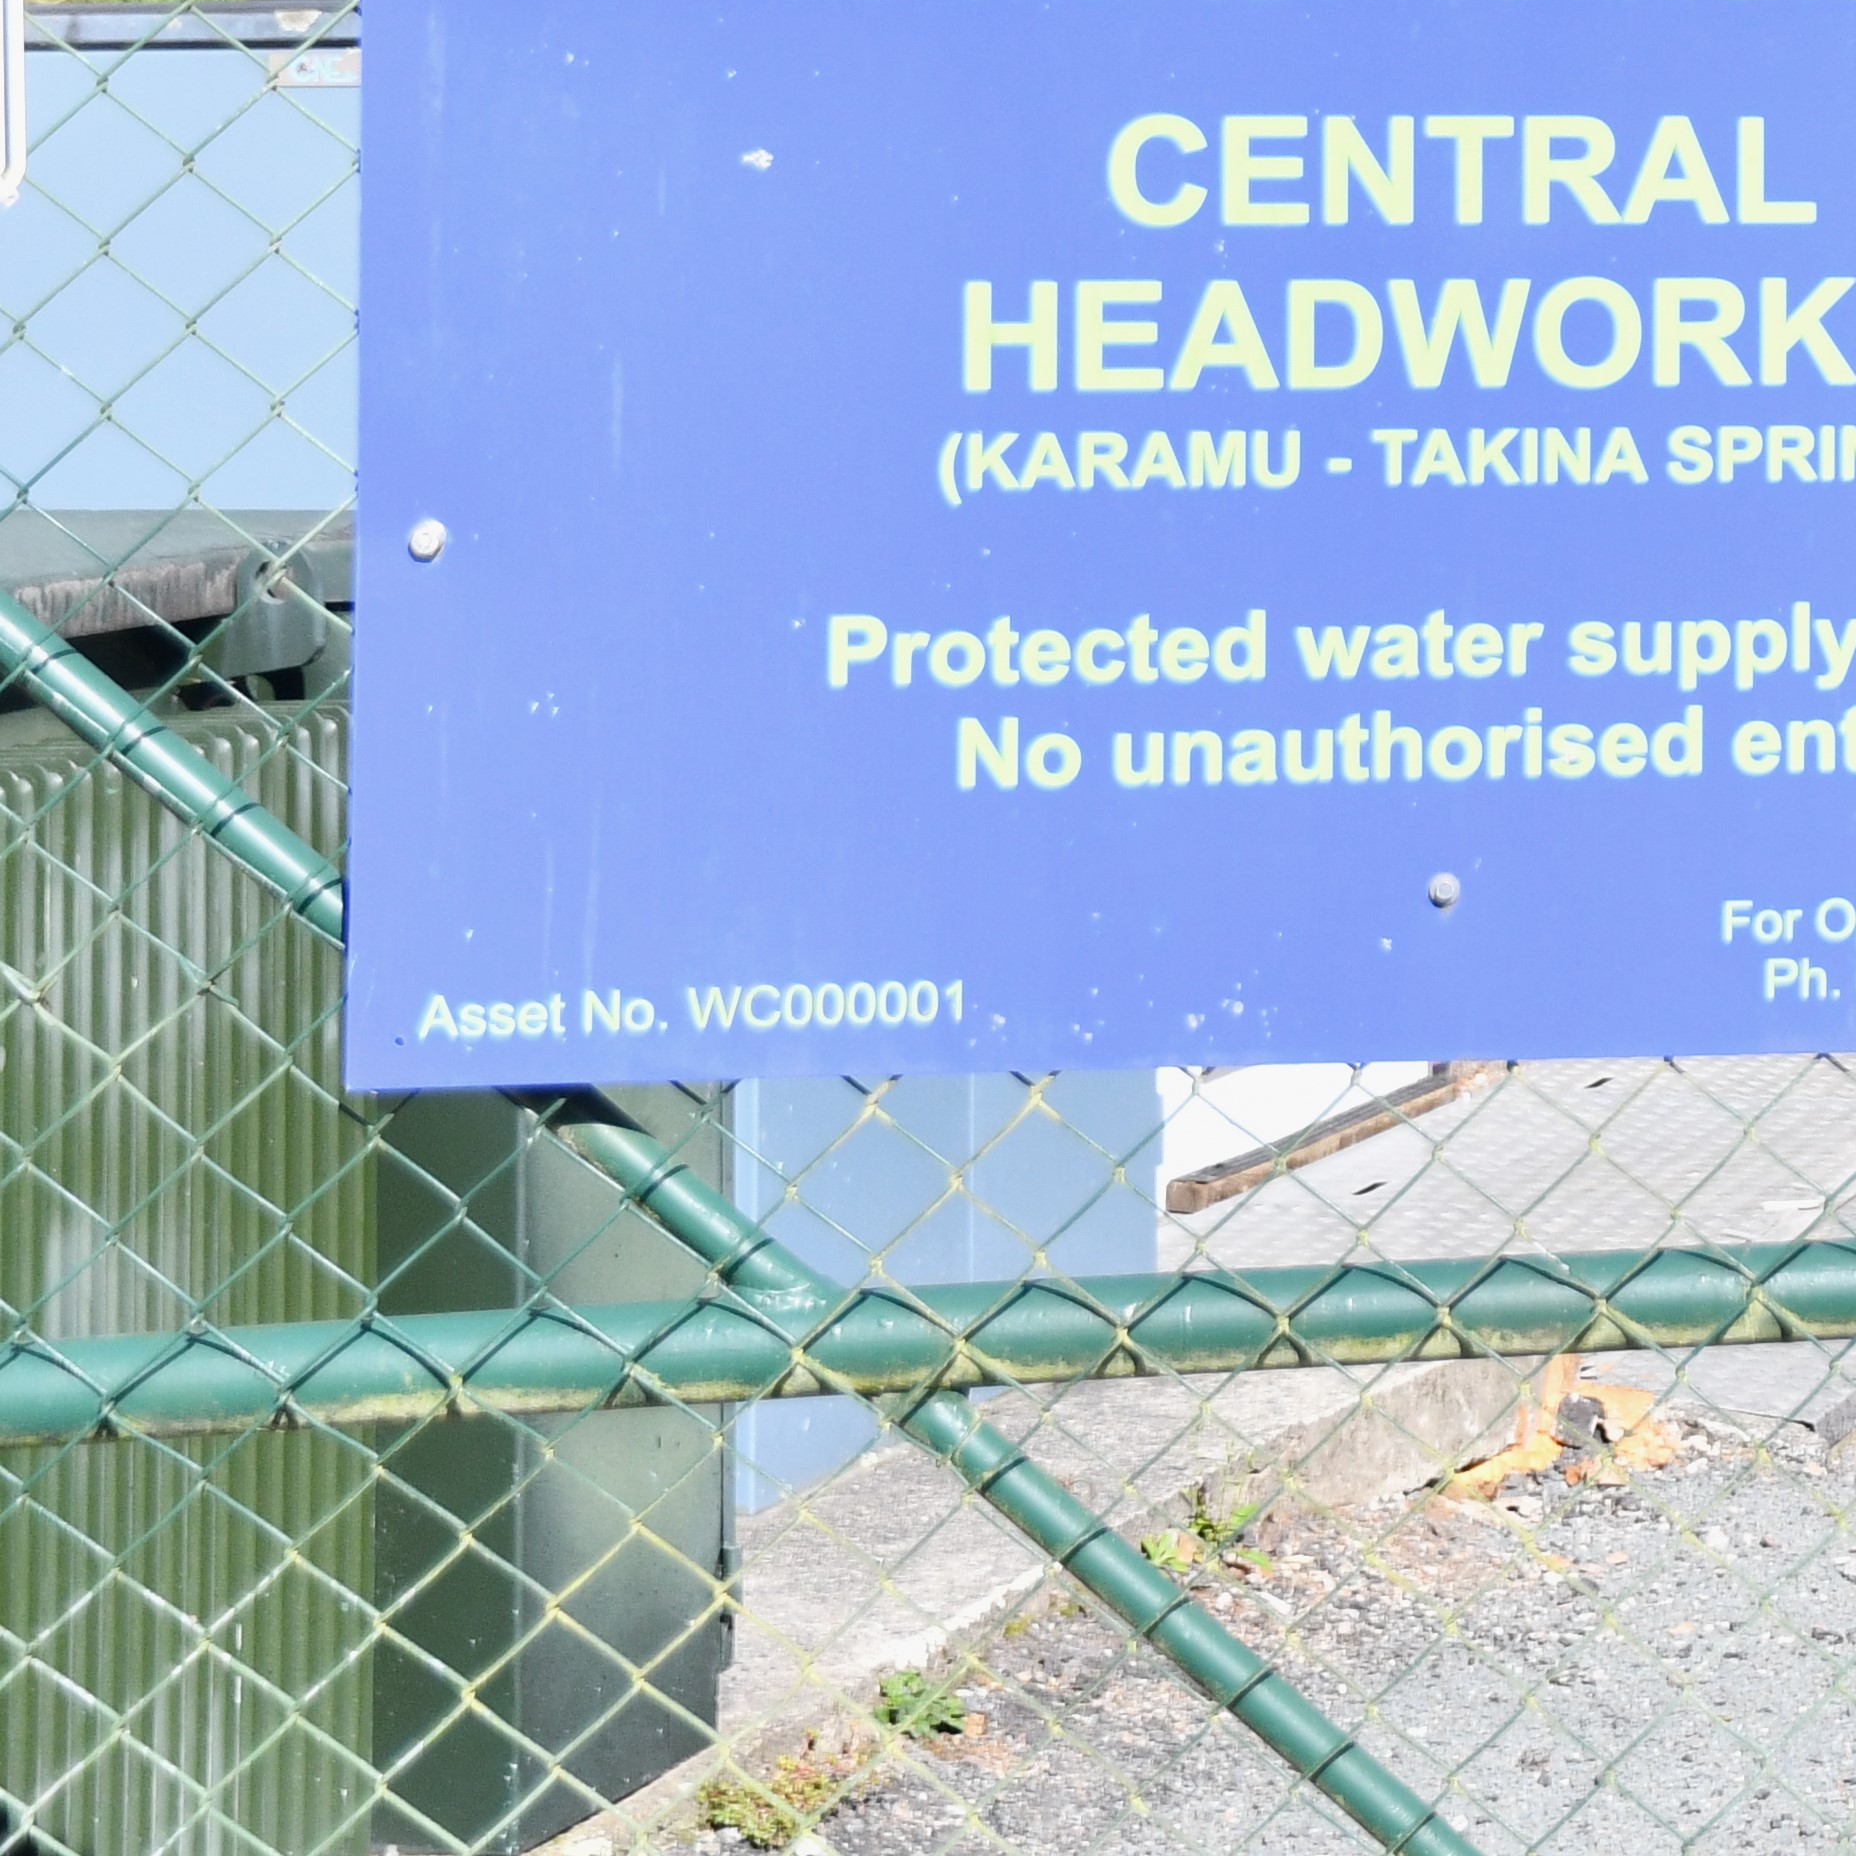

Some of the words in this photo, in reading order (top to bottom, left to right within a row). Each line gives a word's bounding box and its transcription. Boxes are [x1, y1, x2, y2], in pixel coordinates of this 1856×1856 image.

[1108, 113, 1817, 227] CENTRAL
[939, 430, 1301, 506] (KARAMU
[1371, 426, 1649, 486] TAKINA
[828, 609, 1267, 688] Protected
[1296, 609, 1545, 679] water
[958, 716, 1082, 789] No
[1113, 704, 1703, 786] unauthorised
[1723, 900, 1803, 943] For
[418, 993, 566, 1040] Asset
[583, 989, 668, 1034] No.
[687, 979, 963, 1030] WC000001
[1765, 957, 1841, 1000] Ph.
